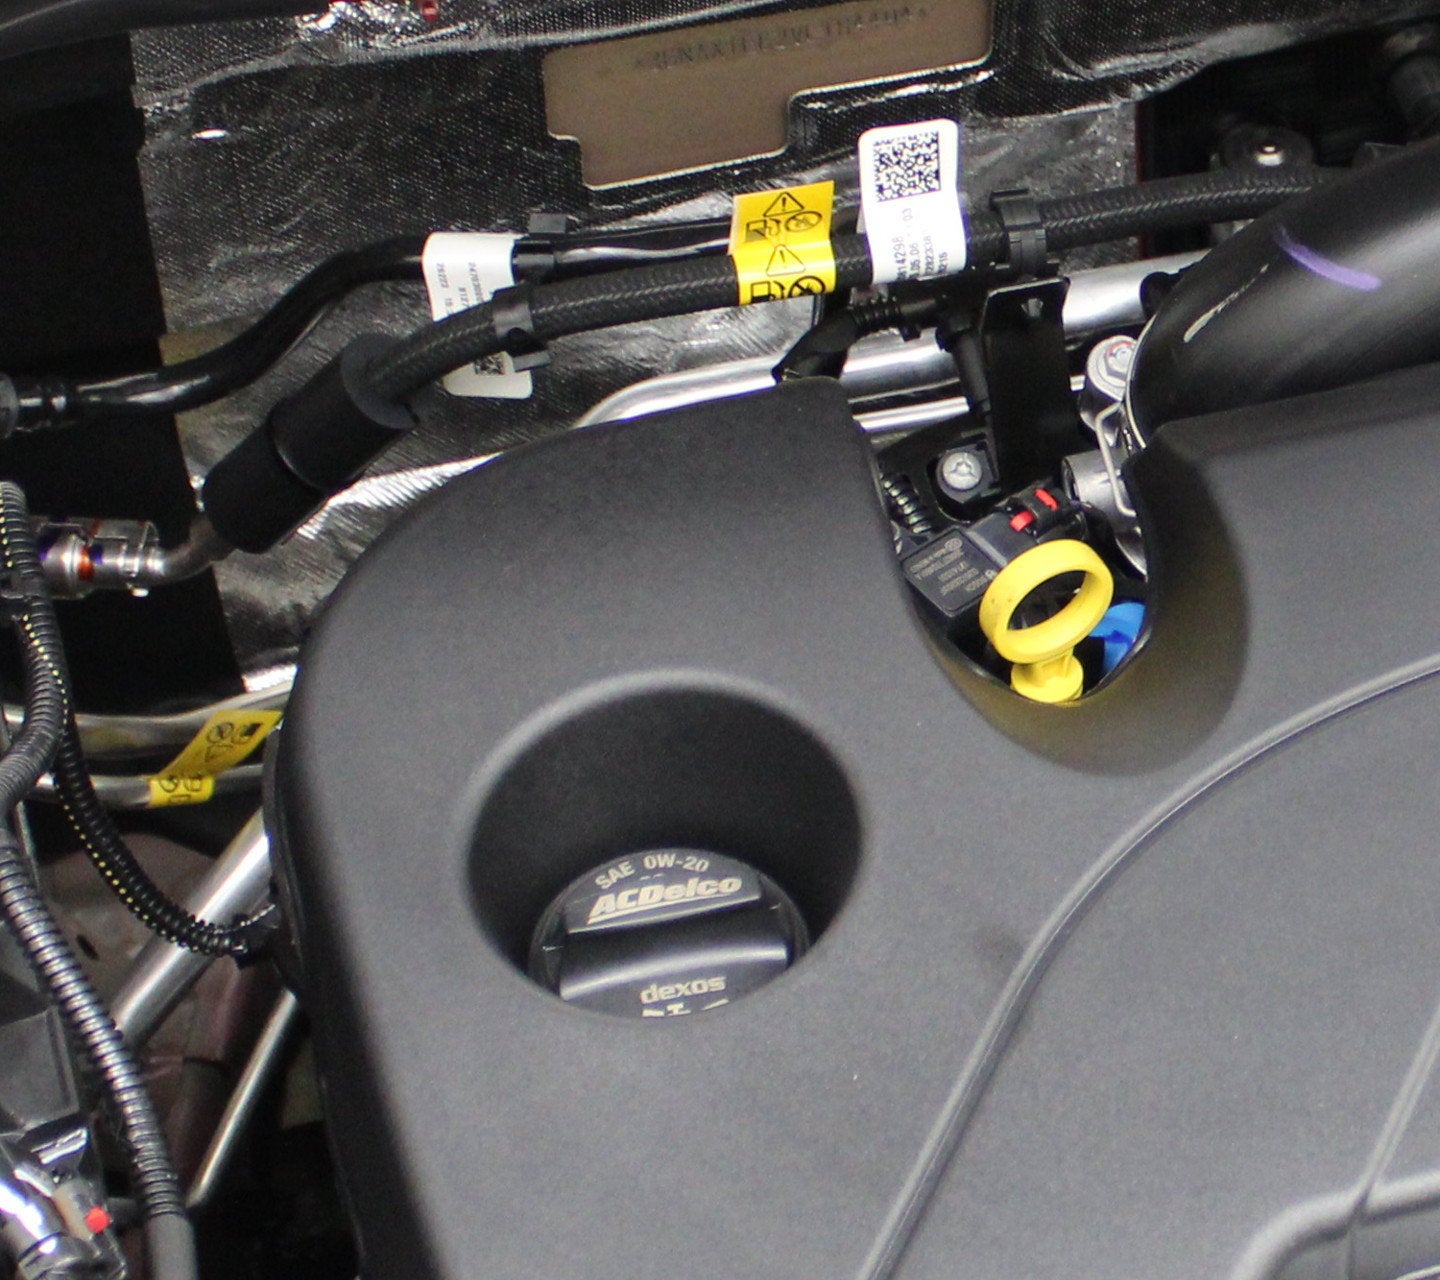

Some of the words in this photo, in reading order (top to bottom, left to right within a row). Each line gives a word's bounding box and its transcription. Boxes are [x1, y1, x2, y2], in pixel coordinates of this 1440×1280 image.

[595, 861, 636, 890] SAE
[643, 852, 710, 874] 0W-20
[588, 875, 743, 922] ACDelco
[639, 975, 727, 1005] dexos
